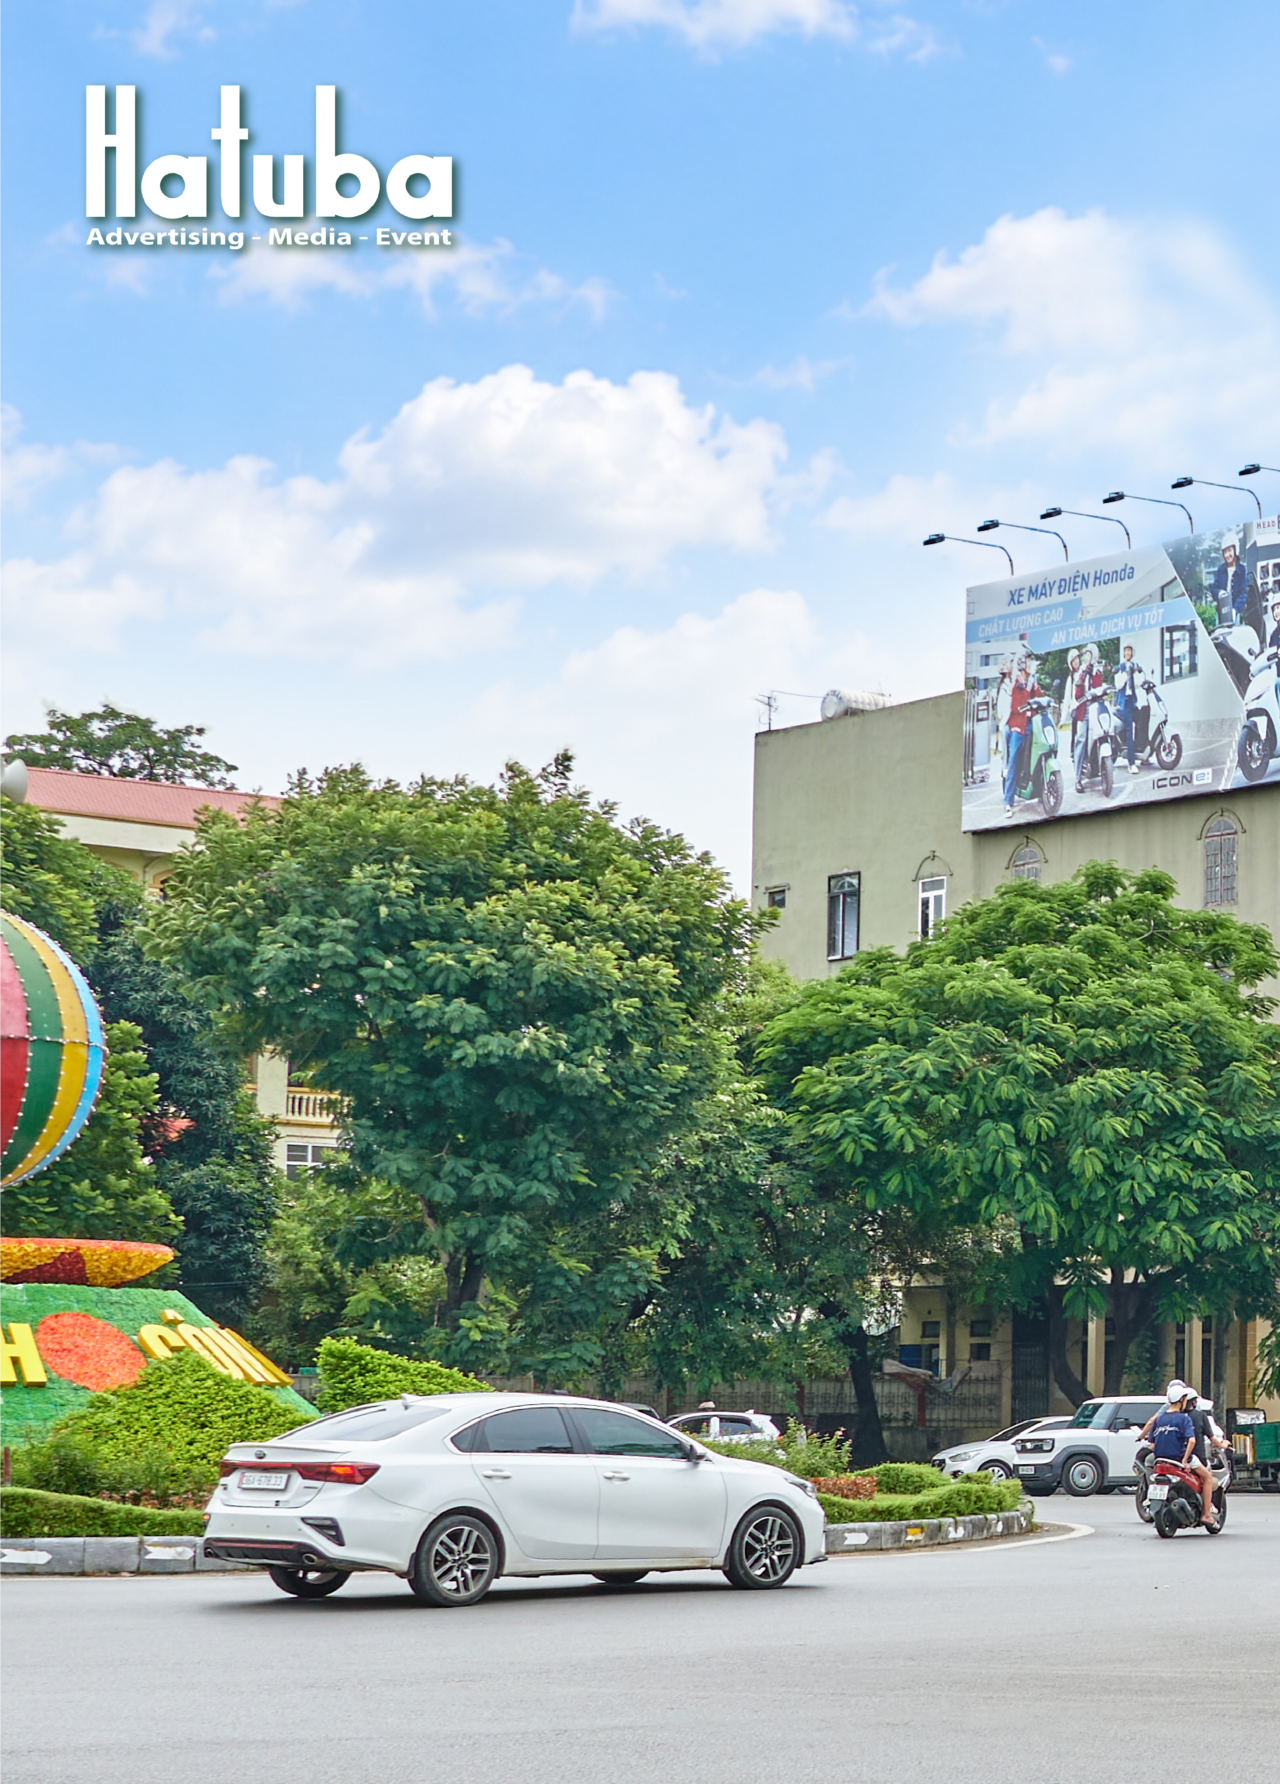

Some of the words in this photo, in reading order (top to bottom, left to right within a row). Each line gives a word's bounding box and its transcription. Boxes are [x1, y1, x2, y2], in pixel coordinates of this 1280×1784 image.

[1256, 520, 1276, 529] HEAD
[1007, 587, 1025, 607] XE
[1027, 578, 1056, 603] MÁY
[1058, 570, 1090, 597] ĐIỆN
[1092, 563, 1135, 587] Honda
[1043, 607, 1064, 624] CAO
[1051, 631, 1067, 646] AN
[1152, 773, 1193, 790] ICON
